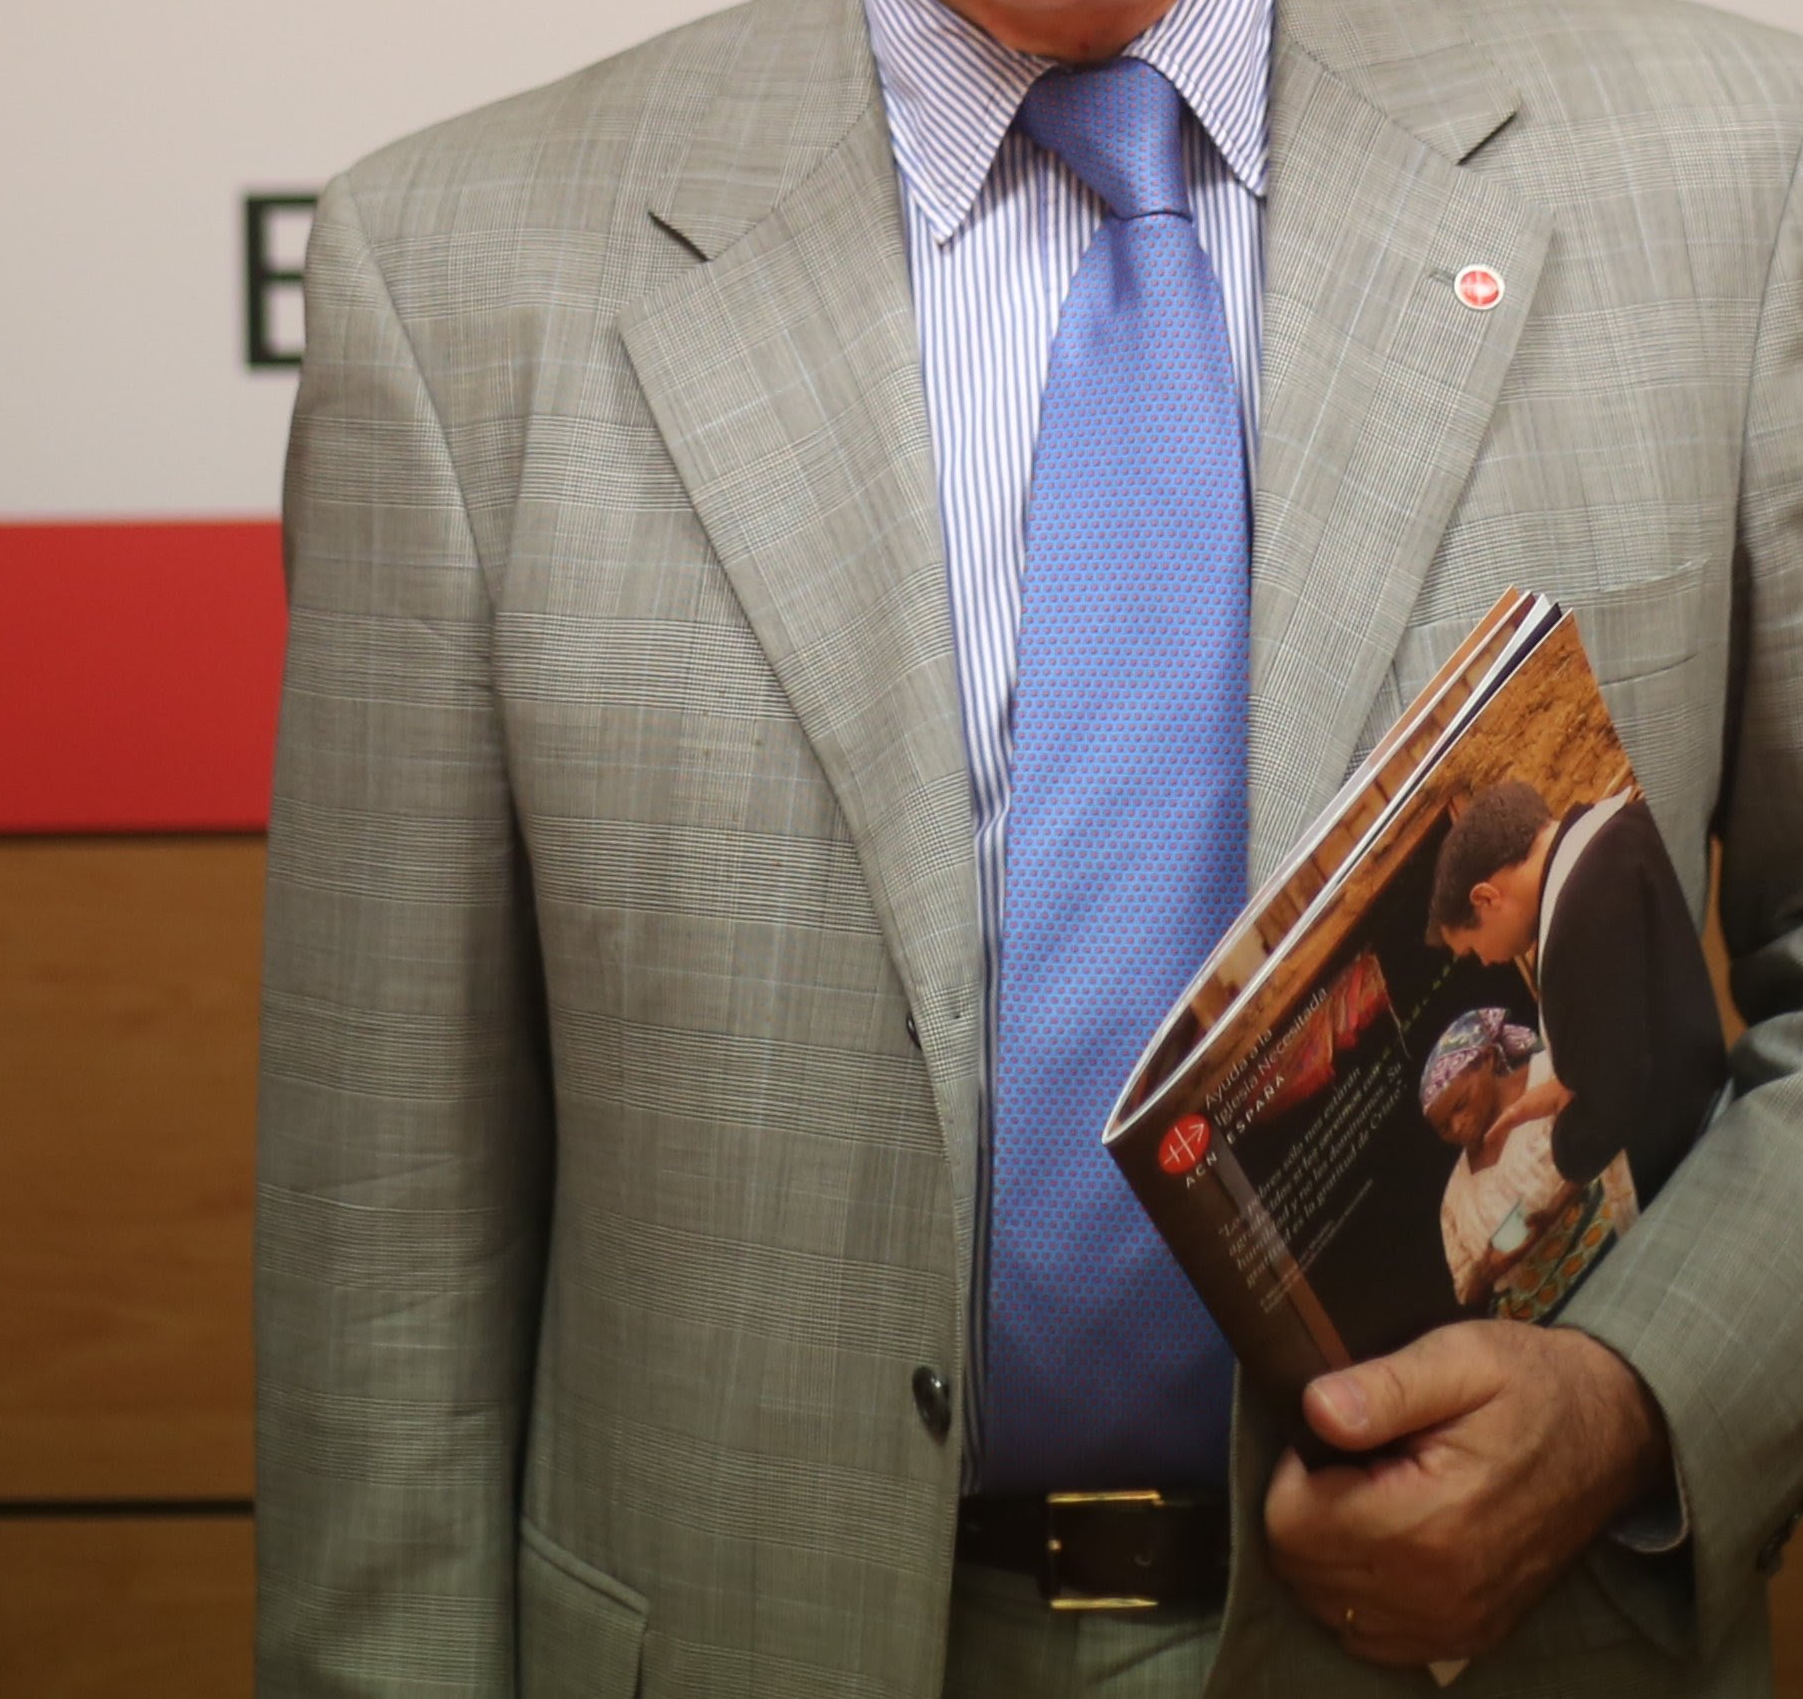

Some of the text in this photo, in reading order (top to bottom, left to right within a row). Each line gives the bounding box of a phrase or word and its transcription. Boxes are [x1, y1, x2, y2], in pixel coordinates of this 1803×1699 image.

[1205, 1057, 1248, 1110] Ayuda
[1214, 987, 1329, 1127] Iglesia Necesitada
[1185, 1073, 1286, 1190] ACN ESPAÑA
